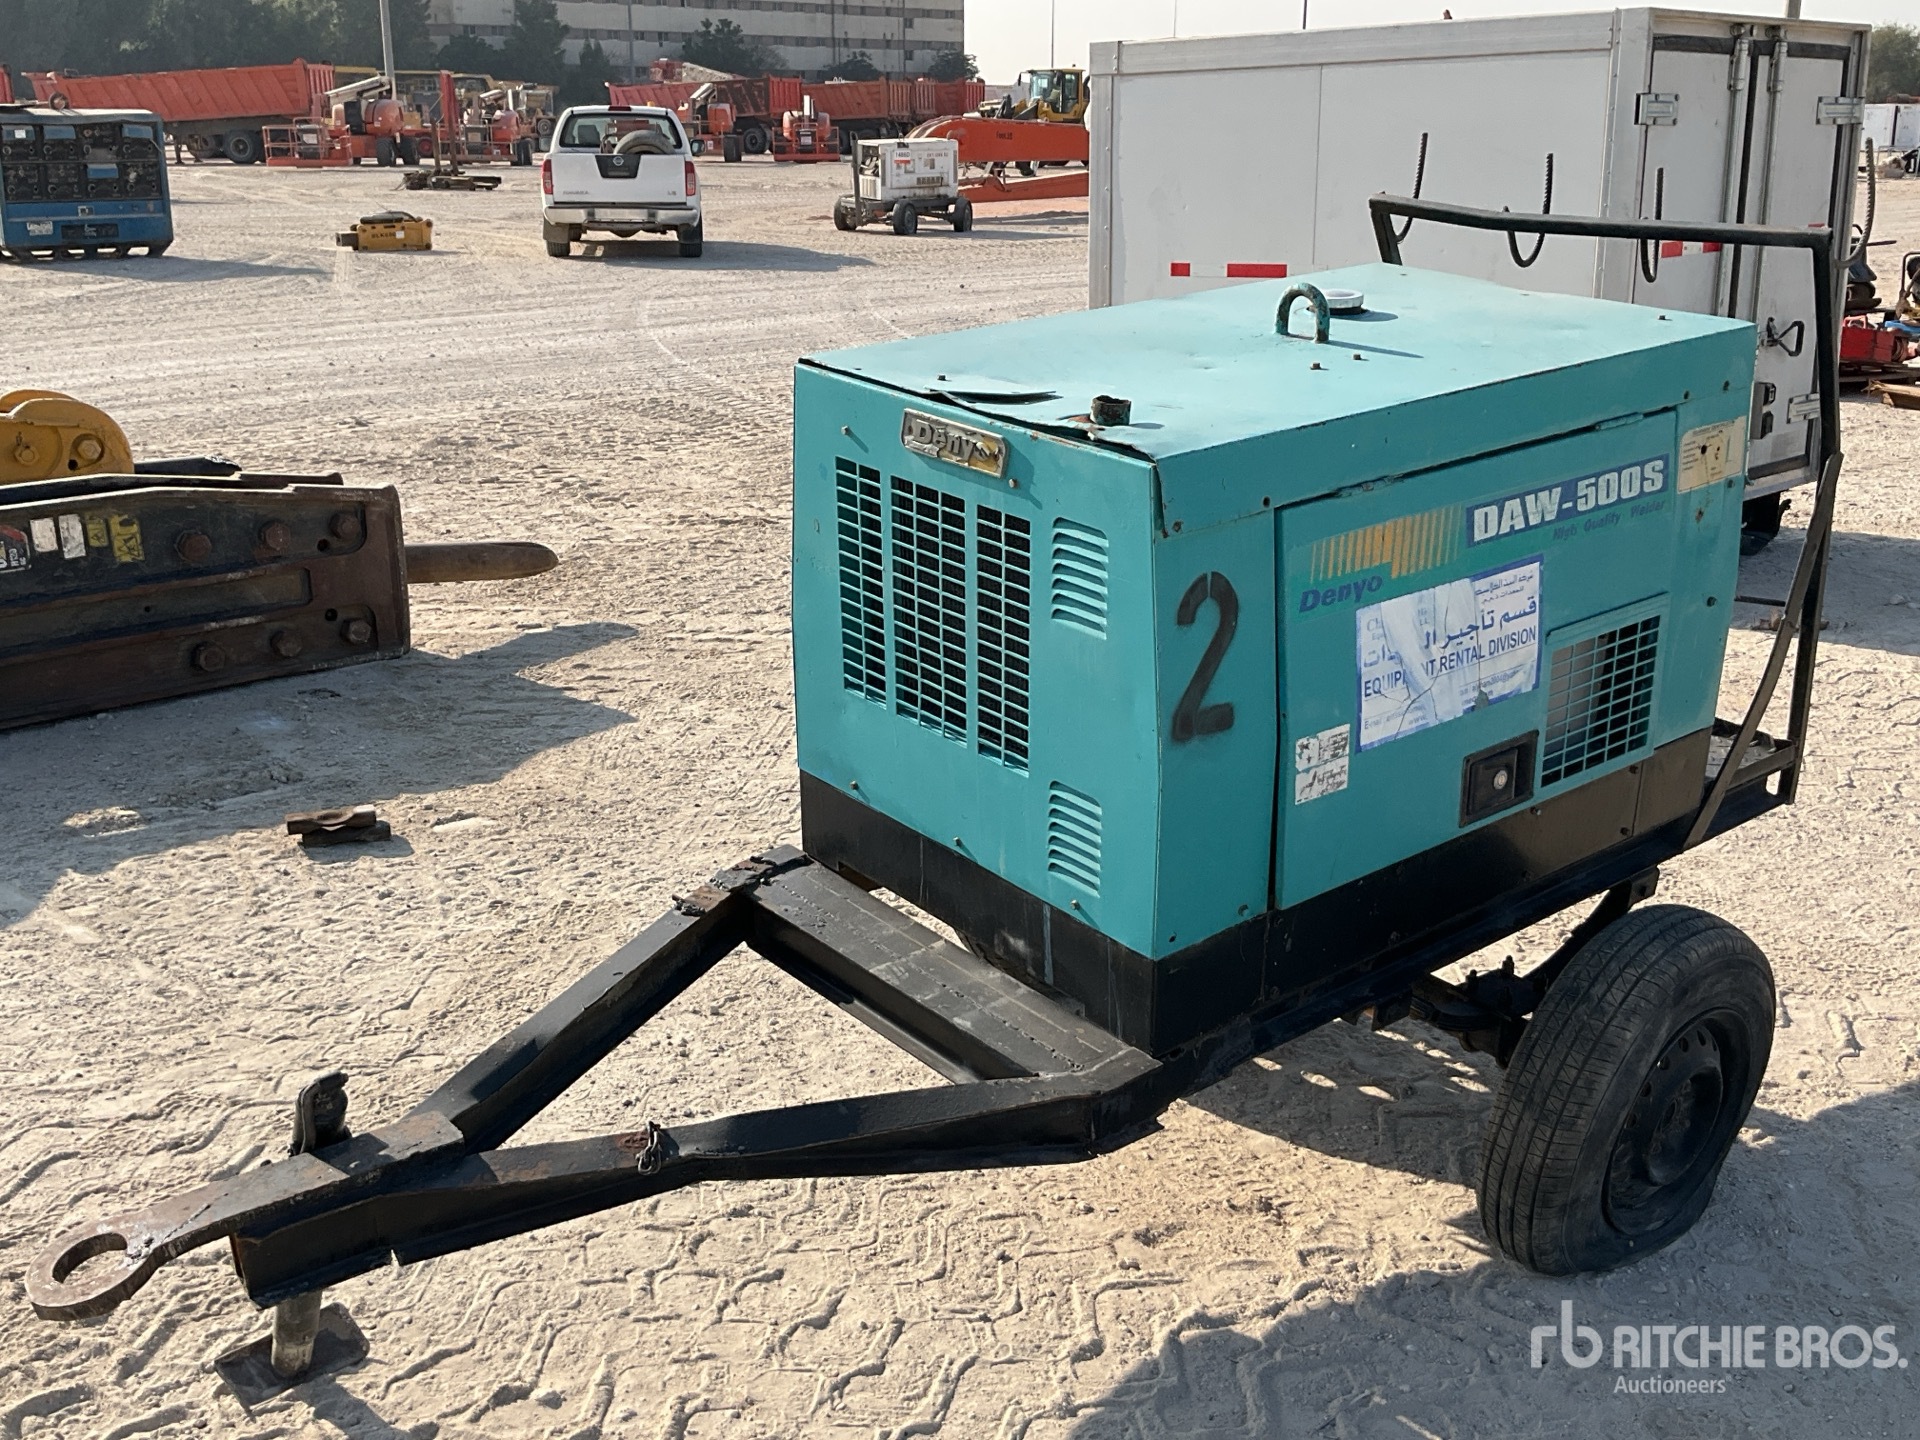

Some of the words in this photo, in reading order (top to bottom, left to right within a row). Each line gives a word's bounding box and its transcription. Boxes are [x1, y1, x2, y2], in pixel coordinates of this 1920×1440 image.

[1473, 459, 1664, 543] DAW-500S
[1552, 527, 1577, 542] High
[1584, 512, 1621, 533] Quality
[1299, 575, 1383, 613] Denyo
[1500, 595, 1537, 631] قسم
[1441, 609, 1495, 649] تأجير
[1173, 571, 1238, 742] 2
[1364, 659, 1437, 698] EQUIPNT
[1440, 643, 1486, 673] RENTAL
[1488, 625, 1537, 656] DIVISION
